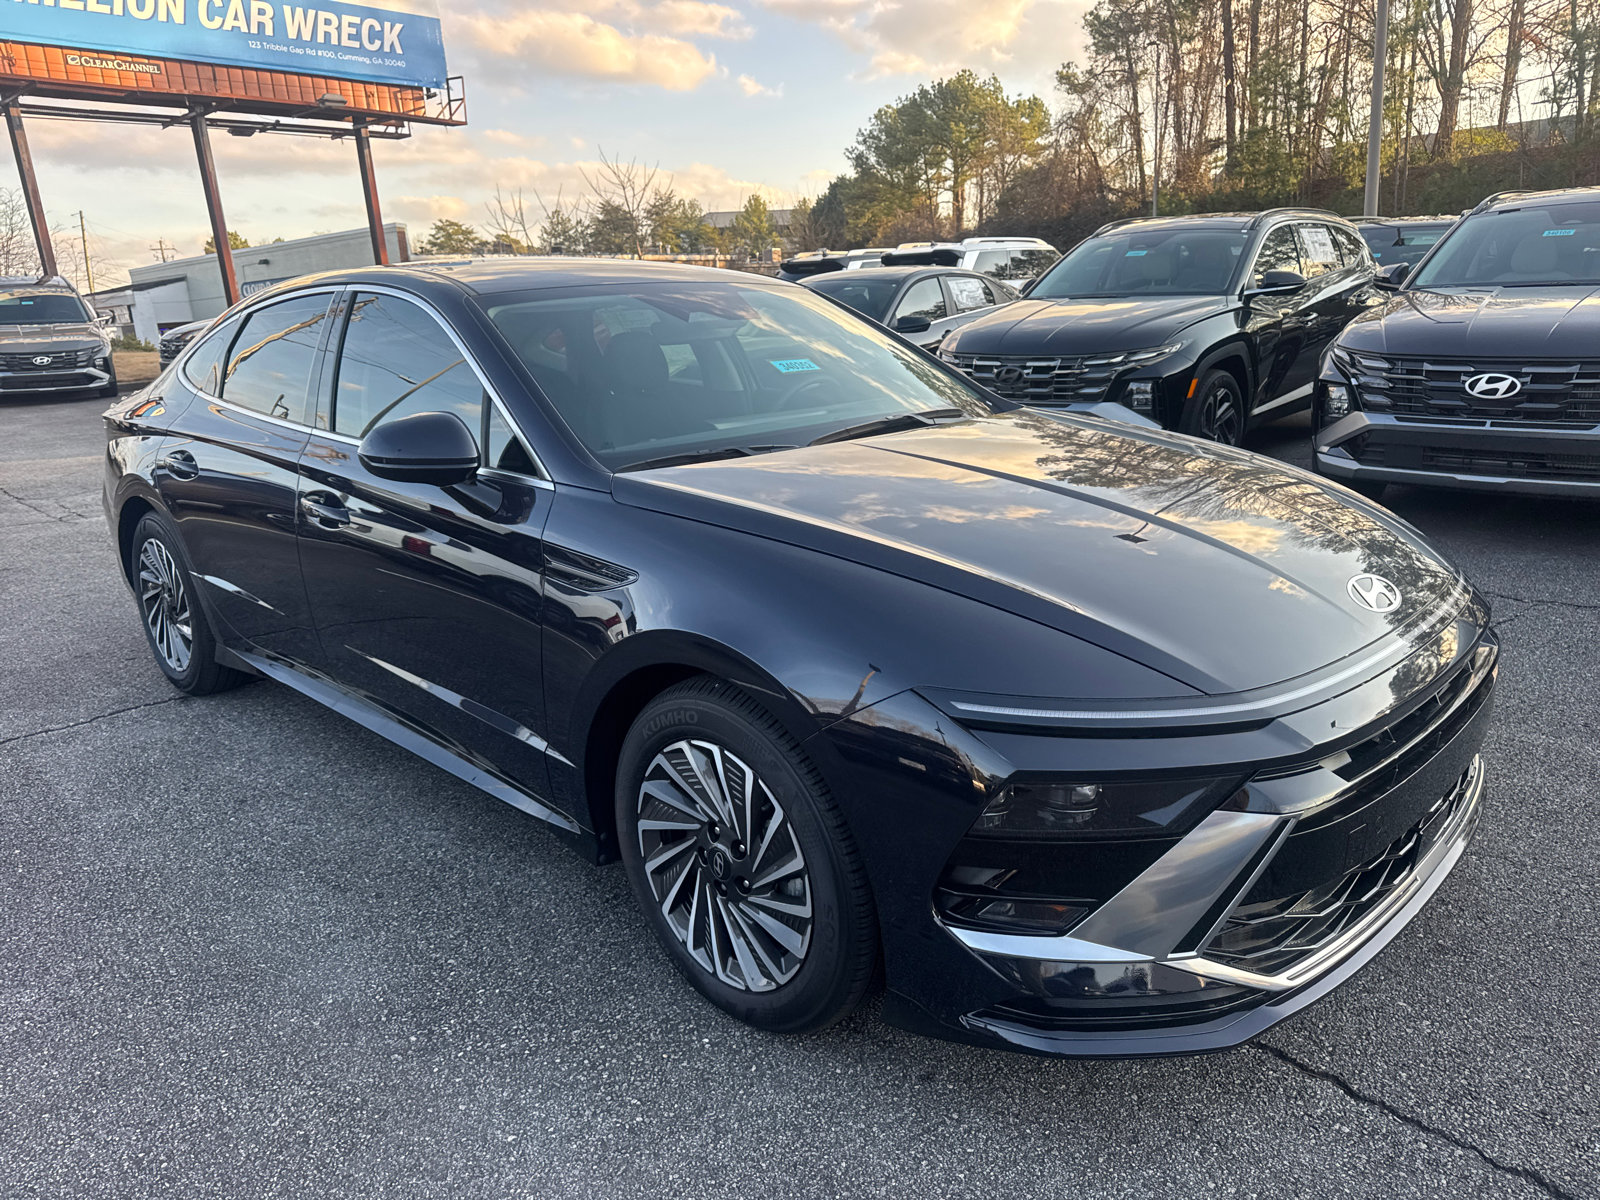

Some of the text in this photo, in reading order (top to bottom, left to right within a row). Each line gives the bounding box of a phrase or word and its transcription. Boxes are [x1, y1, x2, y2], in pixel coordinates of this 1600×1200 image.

[198, 0, 275, 37] CAR
[283, 5, 403, 54] WRECK
[248, 40, 261, 49] 123
[263, 42, 288, 52] Tribble
[289, 45, 304, 55] Gap
[305, 47, 316, 56] Rd
[338, 52, 371, 64] Cumming,
[372, 57, 383, 65] GA
[384, 58, 406, 68] 30040
[642, 710, 698, 740] KUMHO
